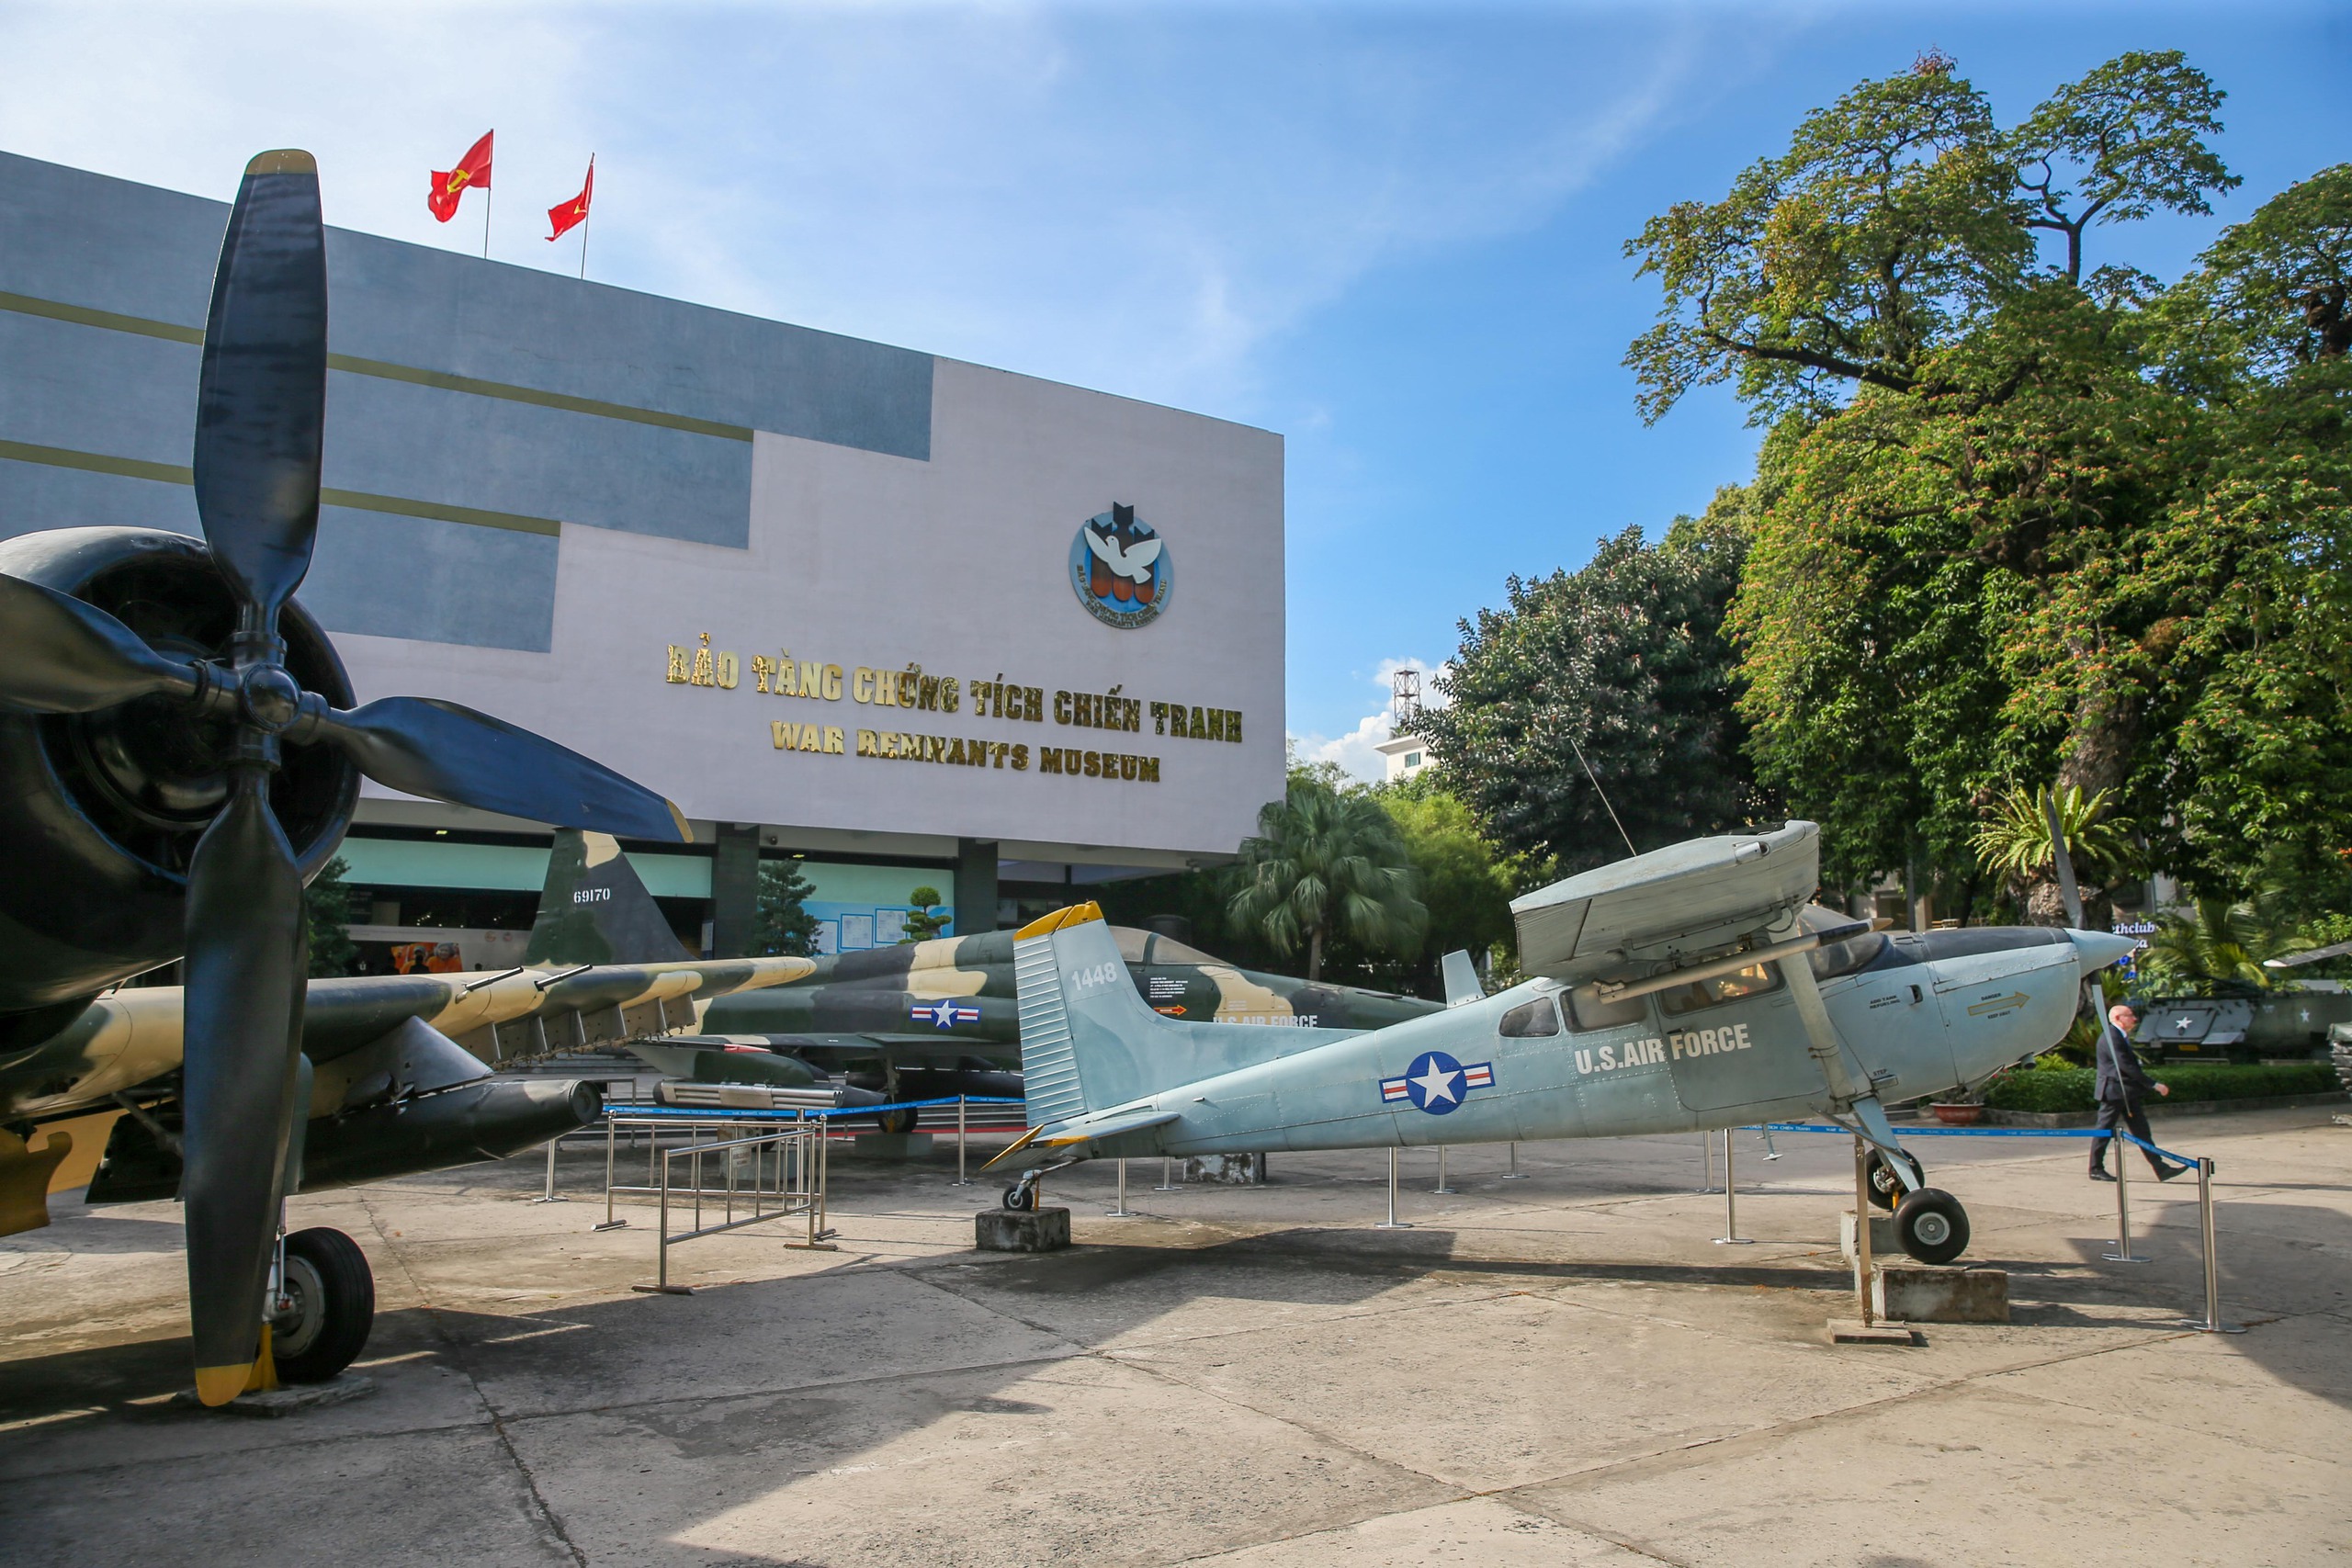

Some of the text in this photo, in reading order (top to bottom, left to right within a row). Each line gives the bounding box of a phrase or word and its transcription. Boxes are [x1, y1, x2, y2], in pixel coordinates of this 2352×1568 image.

[666, 632, 1242, 743] BẢO TÀNG CHỨNG TÍCH CHIẾN TRANH
[770, 719, 1160, 783] WAR REMNANTS MUSEUM
[573, 887, 611, 904] 69170
[1071, 962, 1117, 991] 1448
[1271, 1015, 1318, 1029] FORCE
[1669, 1023, 1752, 1060] FORCE
